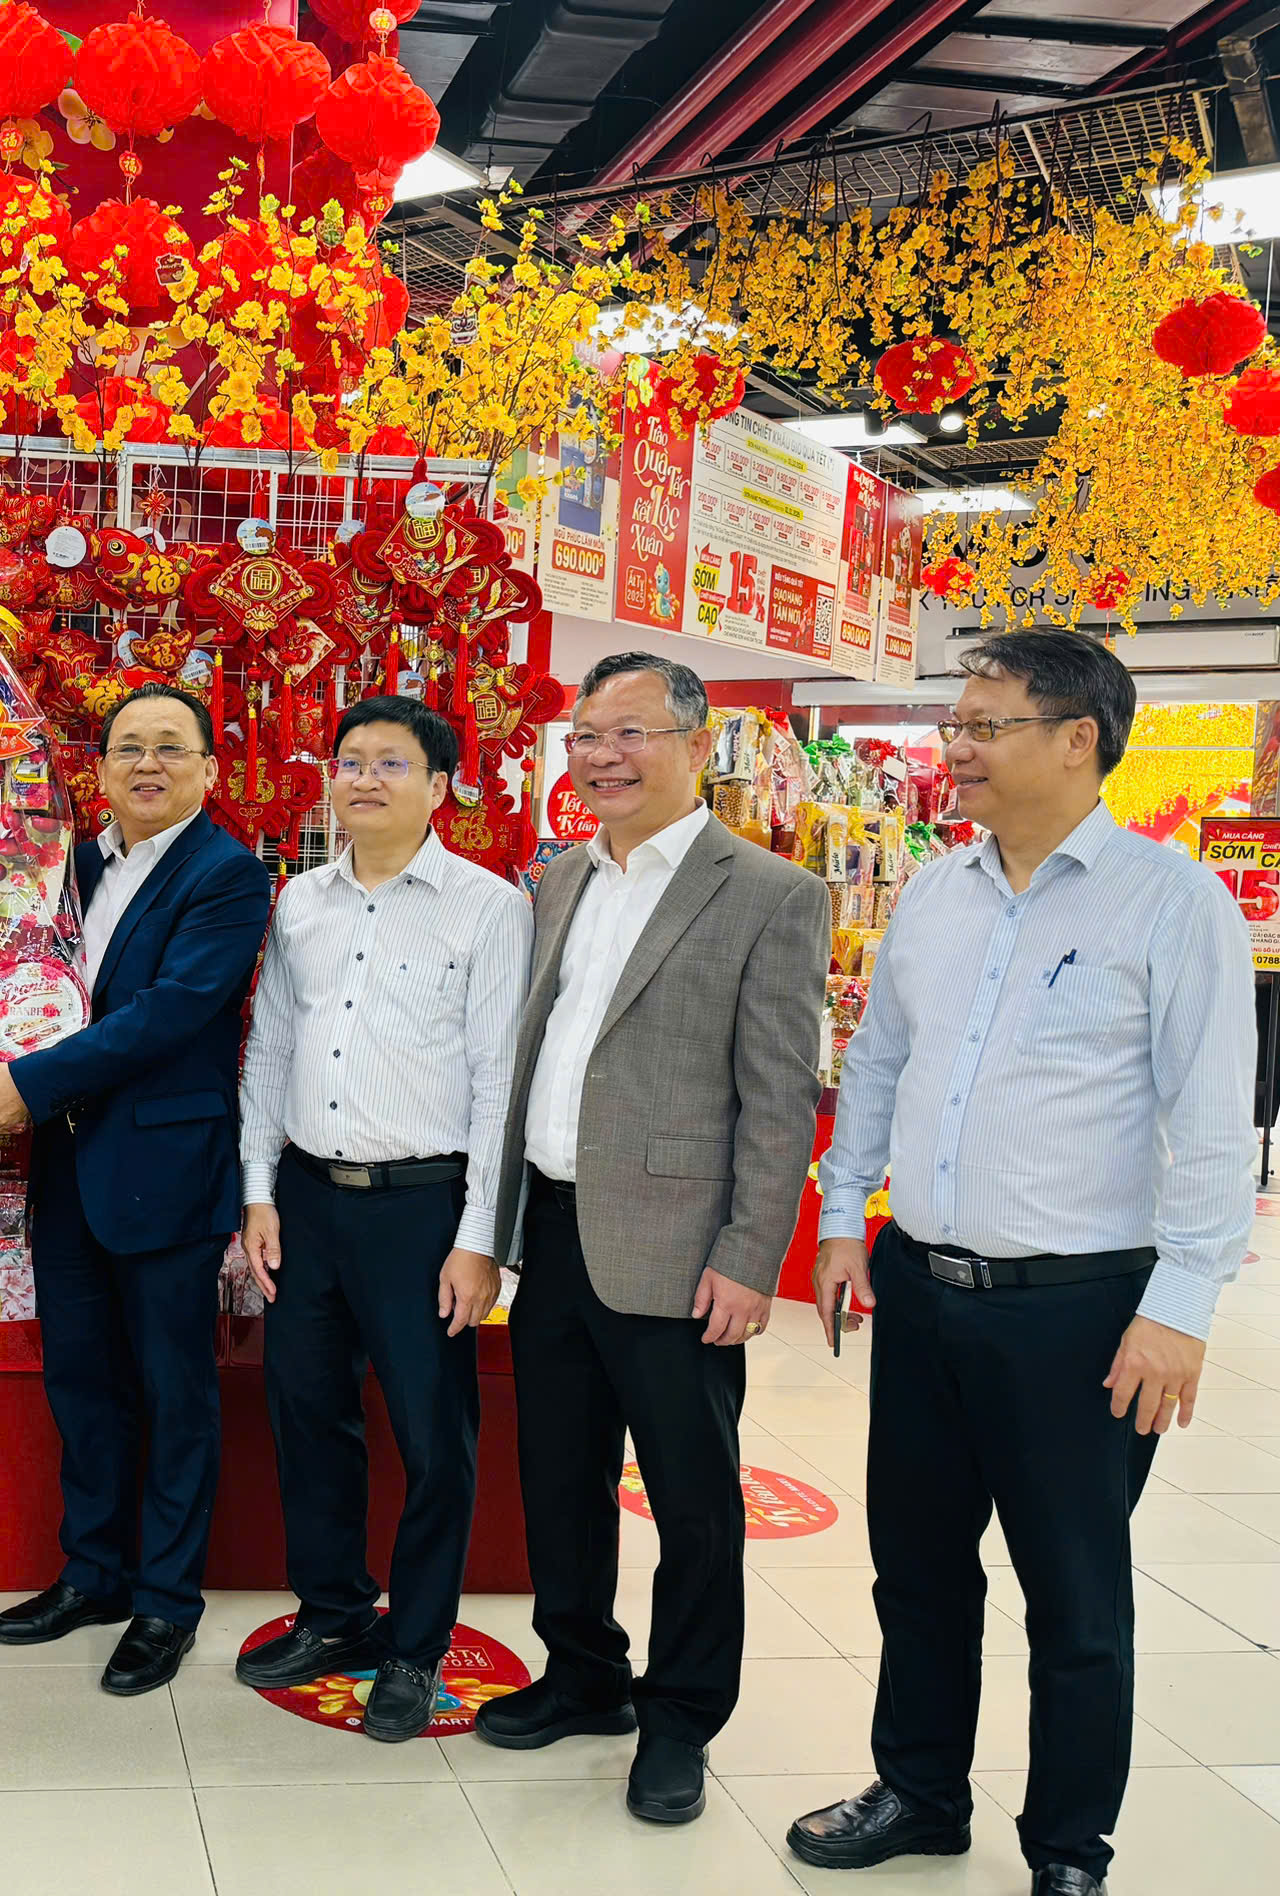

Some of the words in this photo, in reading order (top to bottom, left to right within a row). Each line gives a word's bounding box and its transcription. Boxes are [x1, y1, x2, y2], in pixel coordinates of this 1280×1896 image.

[2, 135, 17, 149] 福
[123, 157, 137, 171] 福
[632, 439, 669, 488] Quà
[667, 465, 691, 500] Tết
[650, 484, 681, 542] Lộc
[630, 523, 664, 562] Xuân
[143, 553, 181, 596] 福
[251, 569, 273, 591] 福
[694, 564, 716, 591] SỚM
[698, 605, 717, 625] CAO
[151, 642, 175, 667] 福
[475, 697, 498, 720] 福
[557, 790, 582, 813] Tết
[576, 815, 597, 832] tấn
[1222, 832, 1241, 840] MUA
[1241, 831, 1265, 840] CÀNG
[1210, 841, 1255, 860] SỚM
[442, 1658, 489, 1668] 2025
[462, 1650, 484, 1663] Tỵ
[431, 1717, 471, 1726] MART
